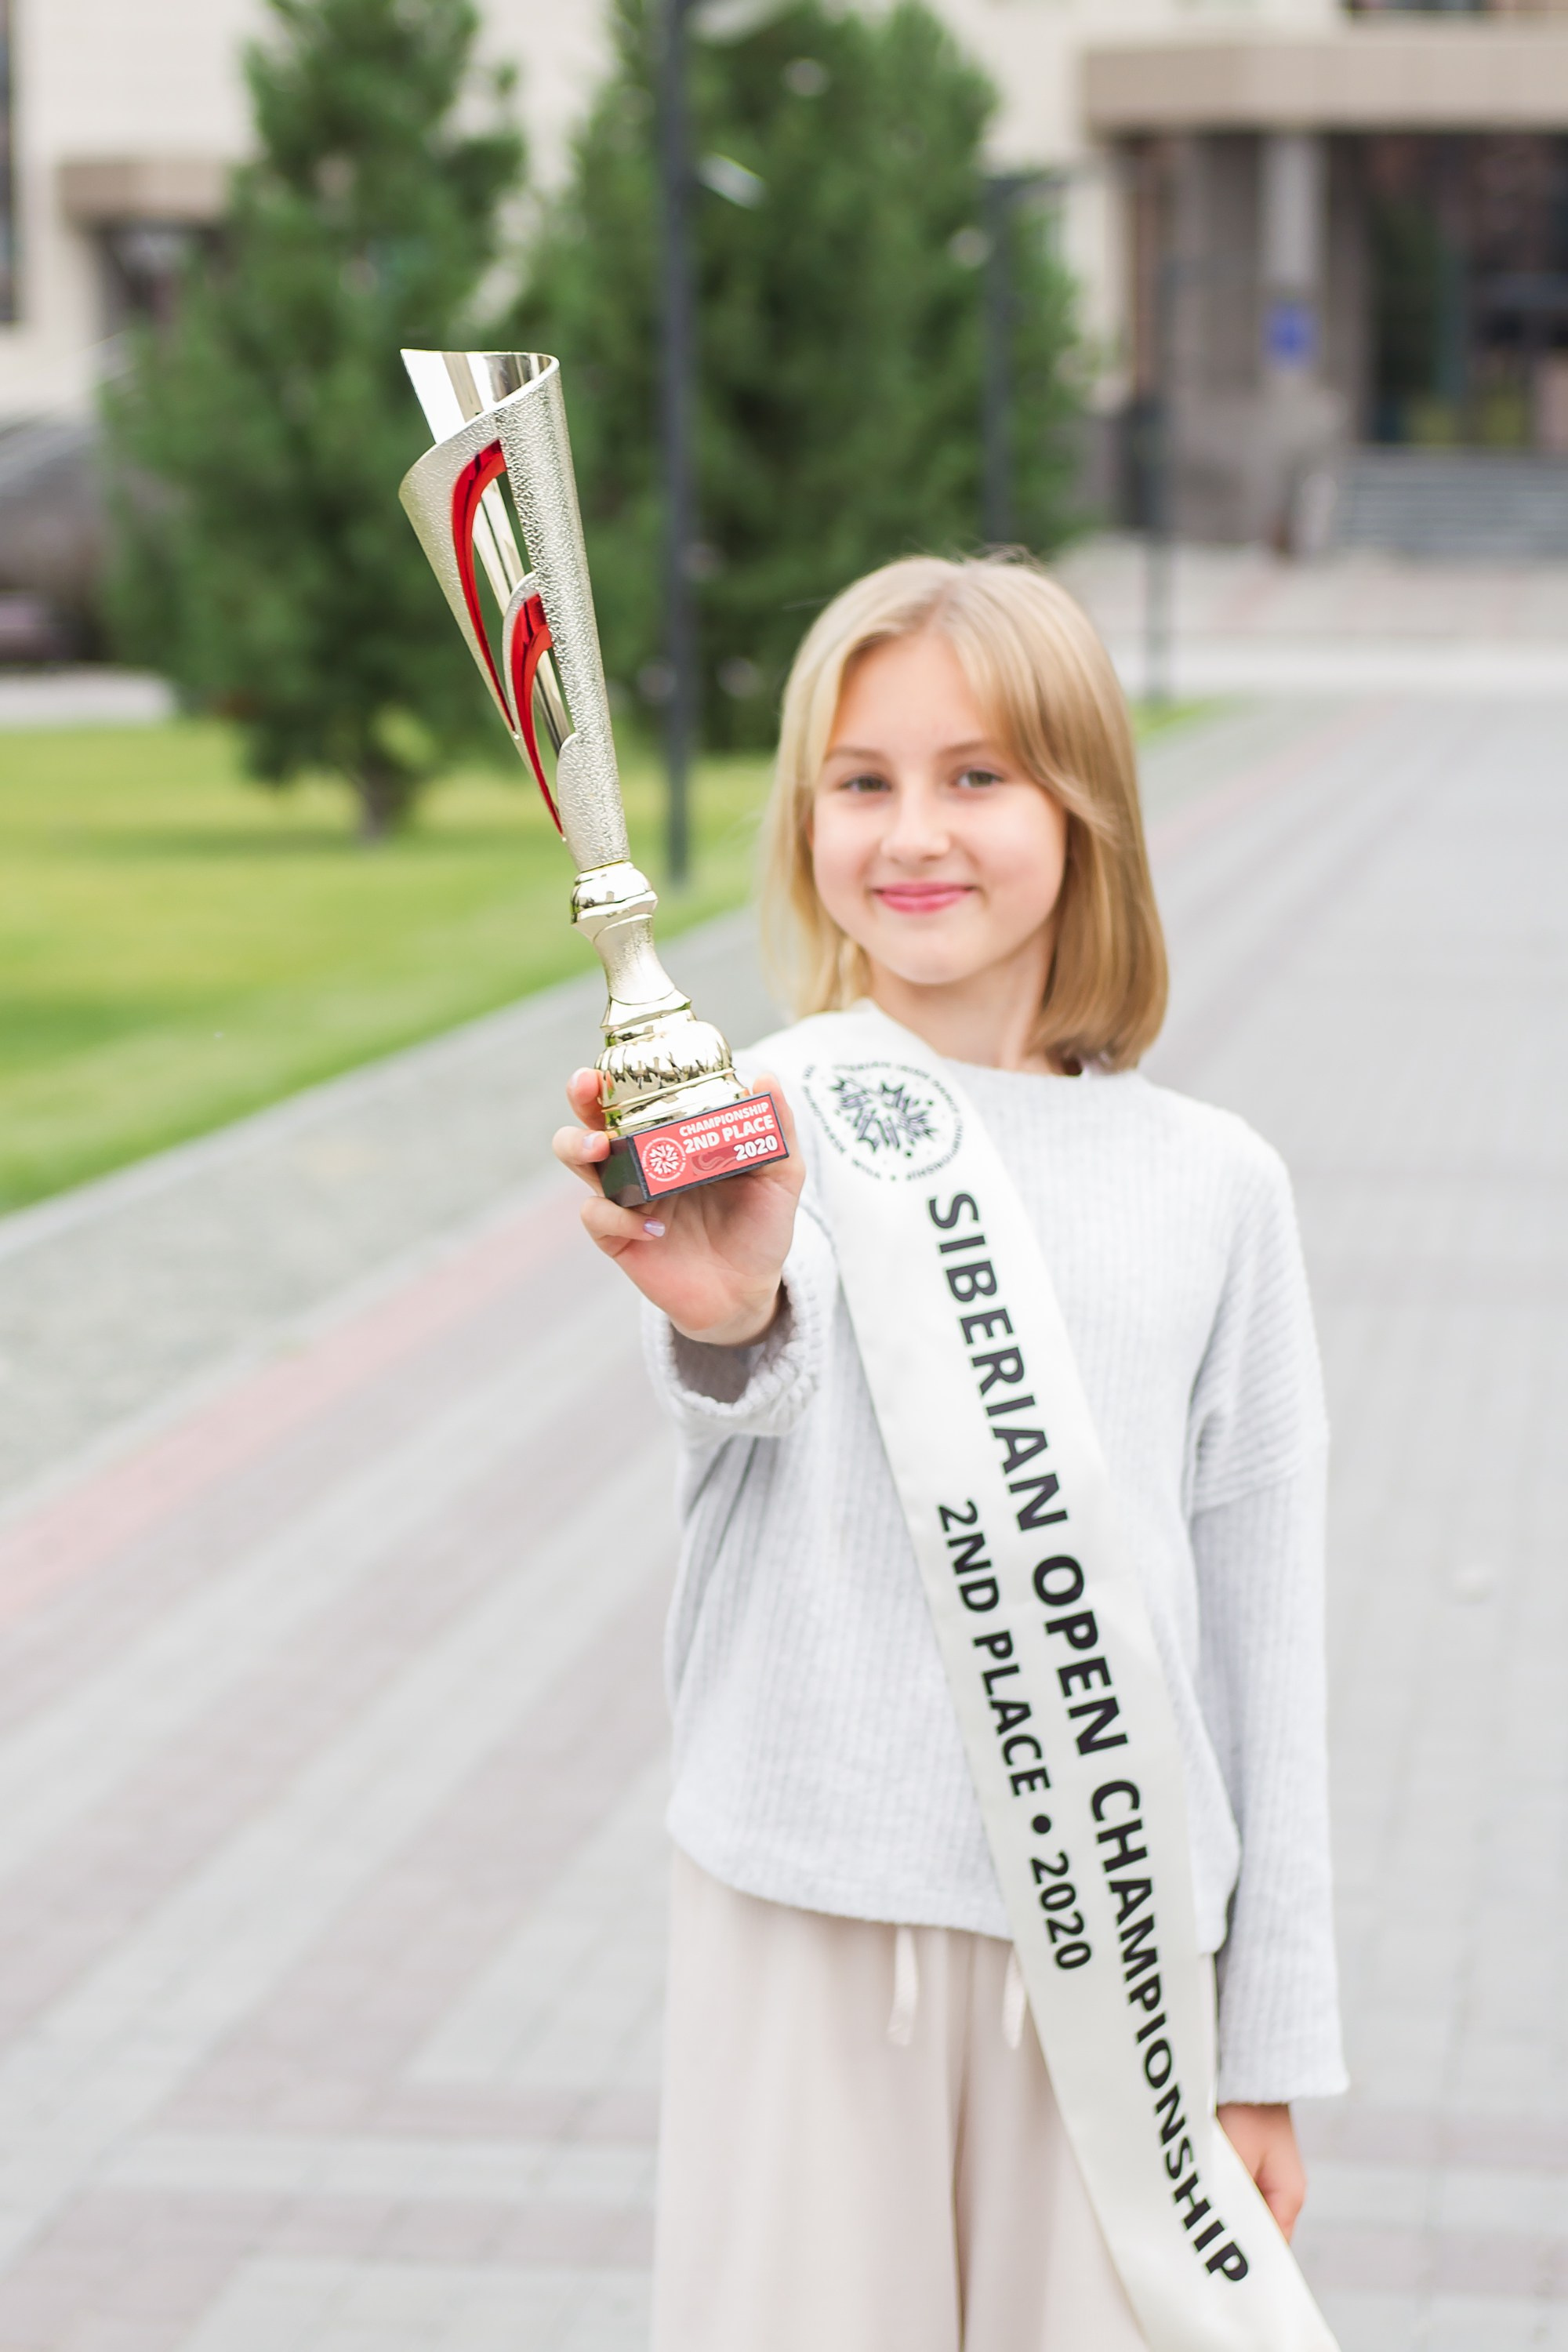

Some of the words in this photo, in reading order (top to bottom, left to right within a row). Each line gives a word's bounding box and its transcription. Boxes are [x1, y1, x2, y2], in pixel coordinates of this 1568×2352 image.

[679, 1102, 769, 1137] CHAMPIONSHIP
[683, 1131, 720, 1154] 2ND
[721, 1115, 775, 1142] PLACE
[733, 1134, 779, 1161] 2020
[927, 1192, 1069, 1533] SIBERIAN
[1032, 1553, 1129, 1757] OPEN
[1089, 1778, 1250, 2283] CHAMPIONSHIP
[937, 1499, 1001, 1614] 2ND
[971, 1628, 1052, 1798] PLACE
[1029, 1849, 1093, 1971] 2020
